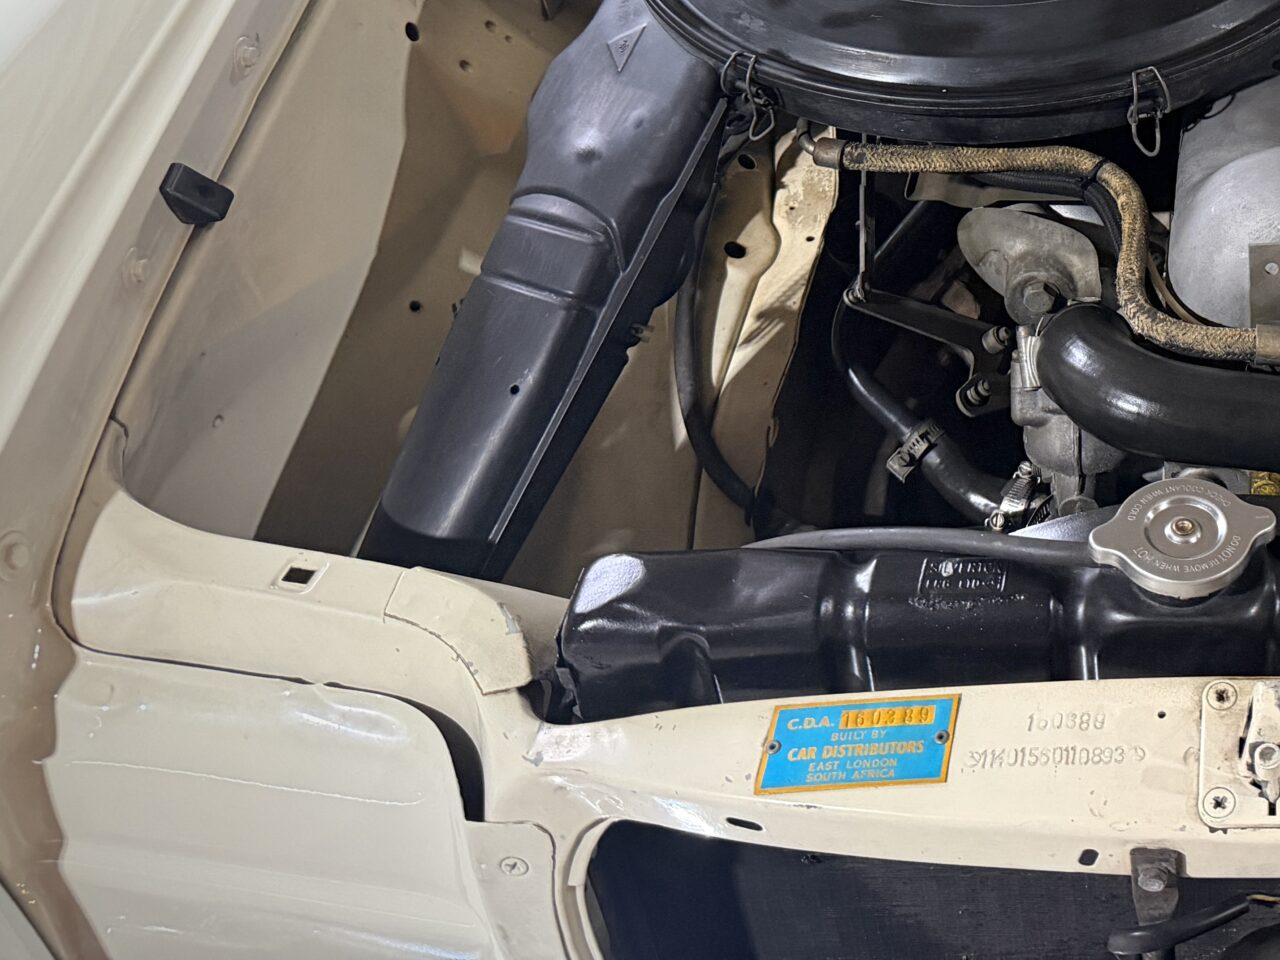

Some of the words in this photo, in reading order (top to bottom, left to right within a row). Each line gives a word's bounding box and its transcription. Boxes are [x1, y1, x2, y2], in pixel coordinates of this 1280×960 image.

[1218, 542, 1237, 561] NOT
[1155, 559, 1180, 573] WHEN
[1183, 559, 1218, 573] REMOVE
[787, 715, 834, 730] C.D.A.
[831, 731, 867, 742] BUILT
[871, 729, 888, 739] BY
[787, 747, 817, 762] CAR
[822, 740, 925, 760] DISTRIBUTORS
[808, 761, 840, 772] EAST
[846, 758, 898, 770] LONDON
[806, 772, 848, 783] SOUTH
[851, 769, 896, 781] AFRICA
